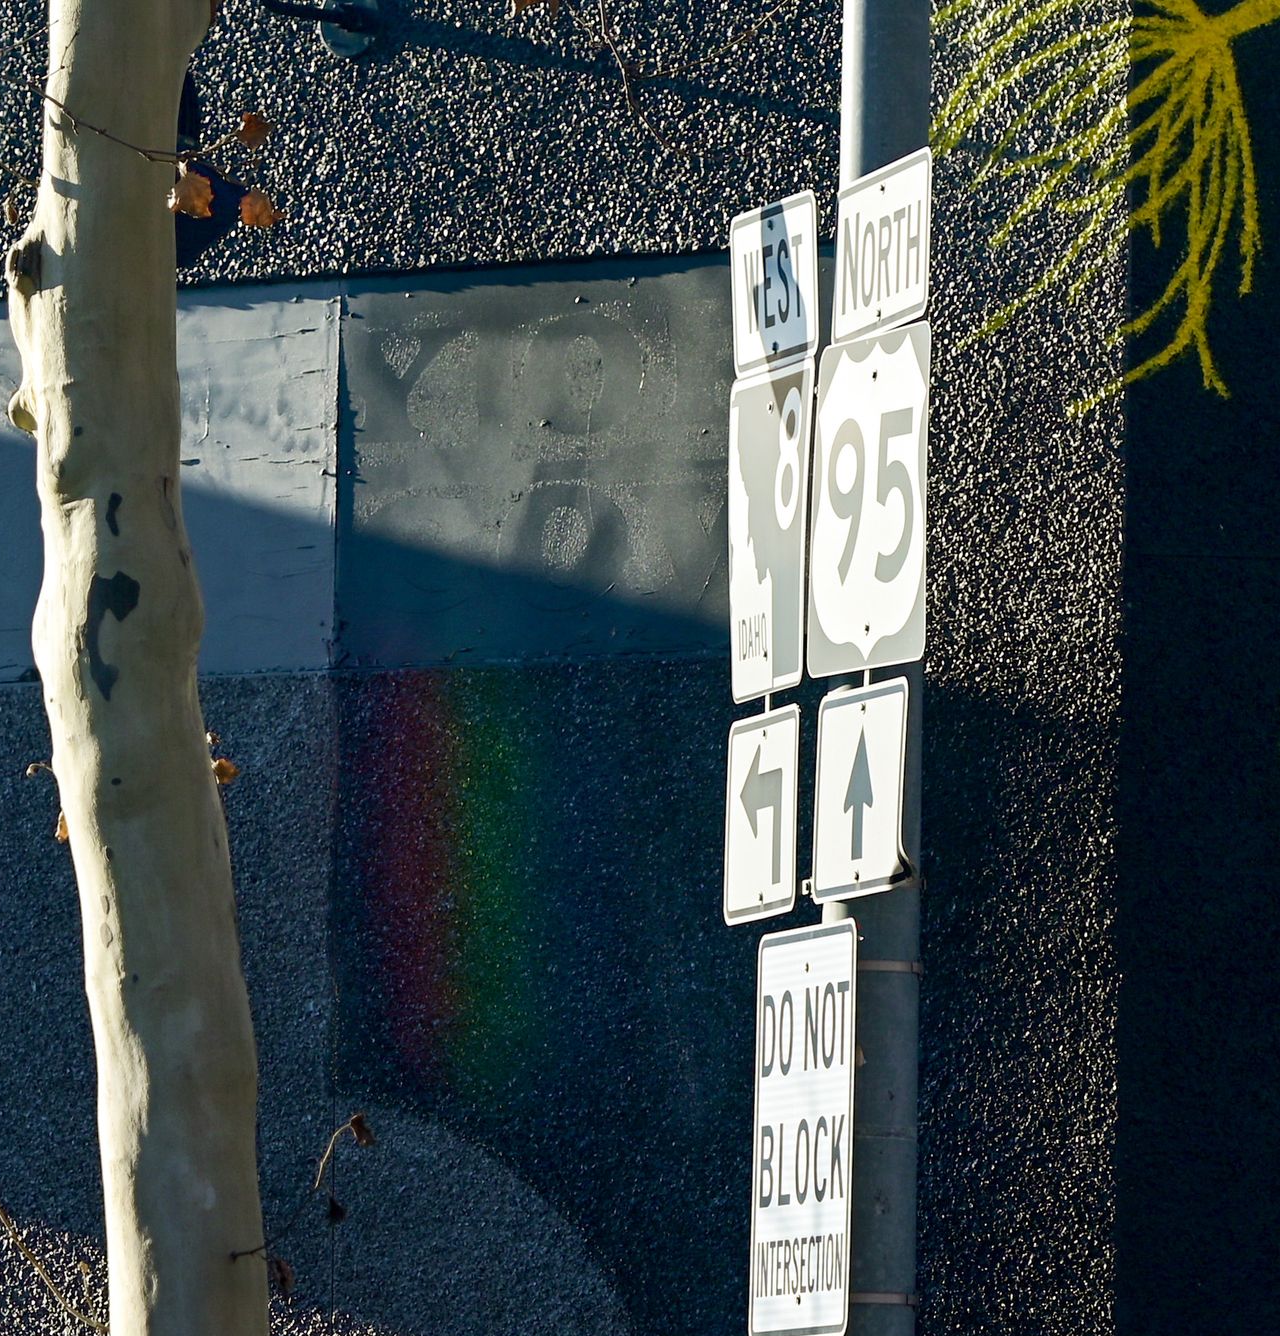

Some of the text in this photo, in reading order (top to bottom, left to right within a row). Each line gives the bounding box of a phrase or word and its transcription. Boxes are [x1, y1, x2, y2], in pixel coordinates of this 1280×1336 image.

[744, 233, 803, 334] WEST
[841, 199, 922, 316] NORTH
[775, 387, 802, 531] 8
[827, 406, 914, 587] 95
[738, 612, 768, 662] IDAHO
[761, 980, 850, 1078] DO NOT
[758, 1113, 845, 1209] BLOCK
[756, 1232, 844, 1298] INTERSECTION
